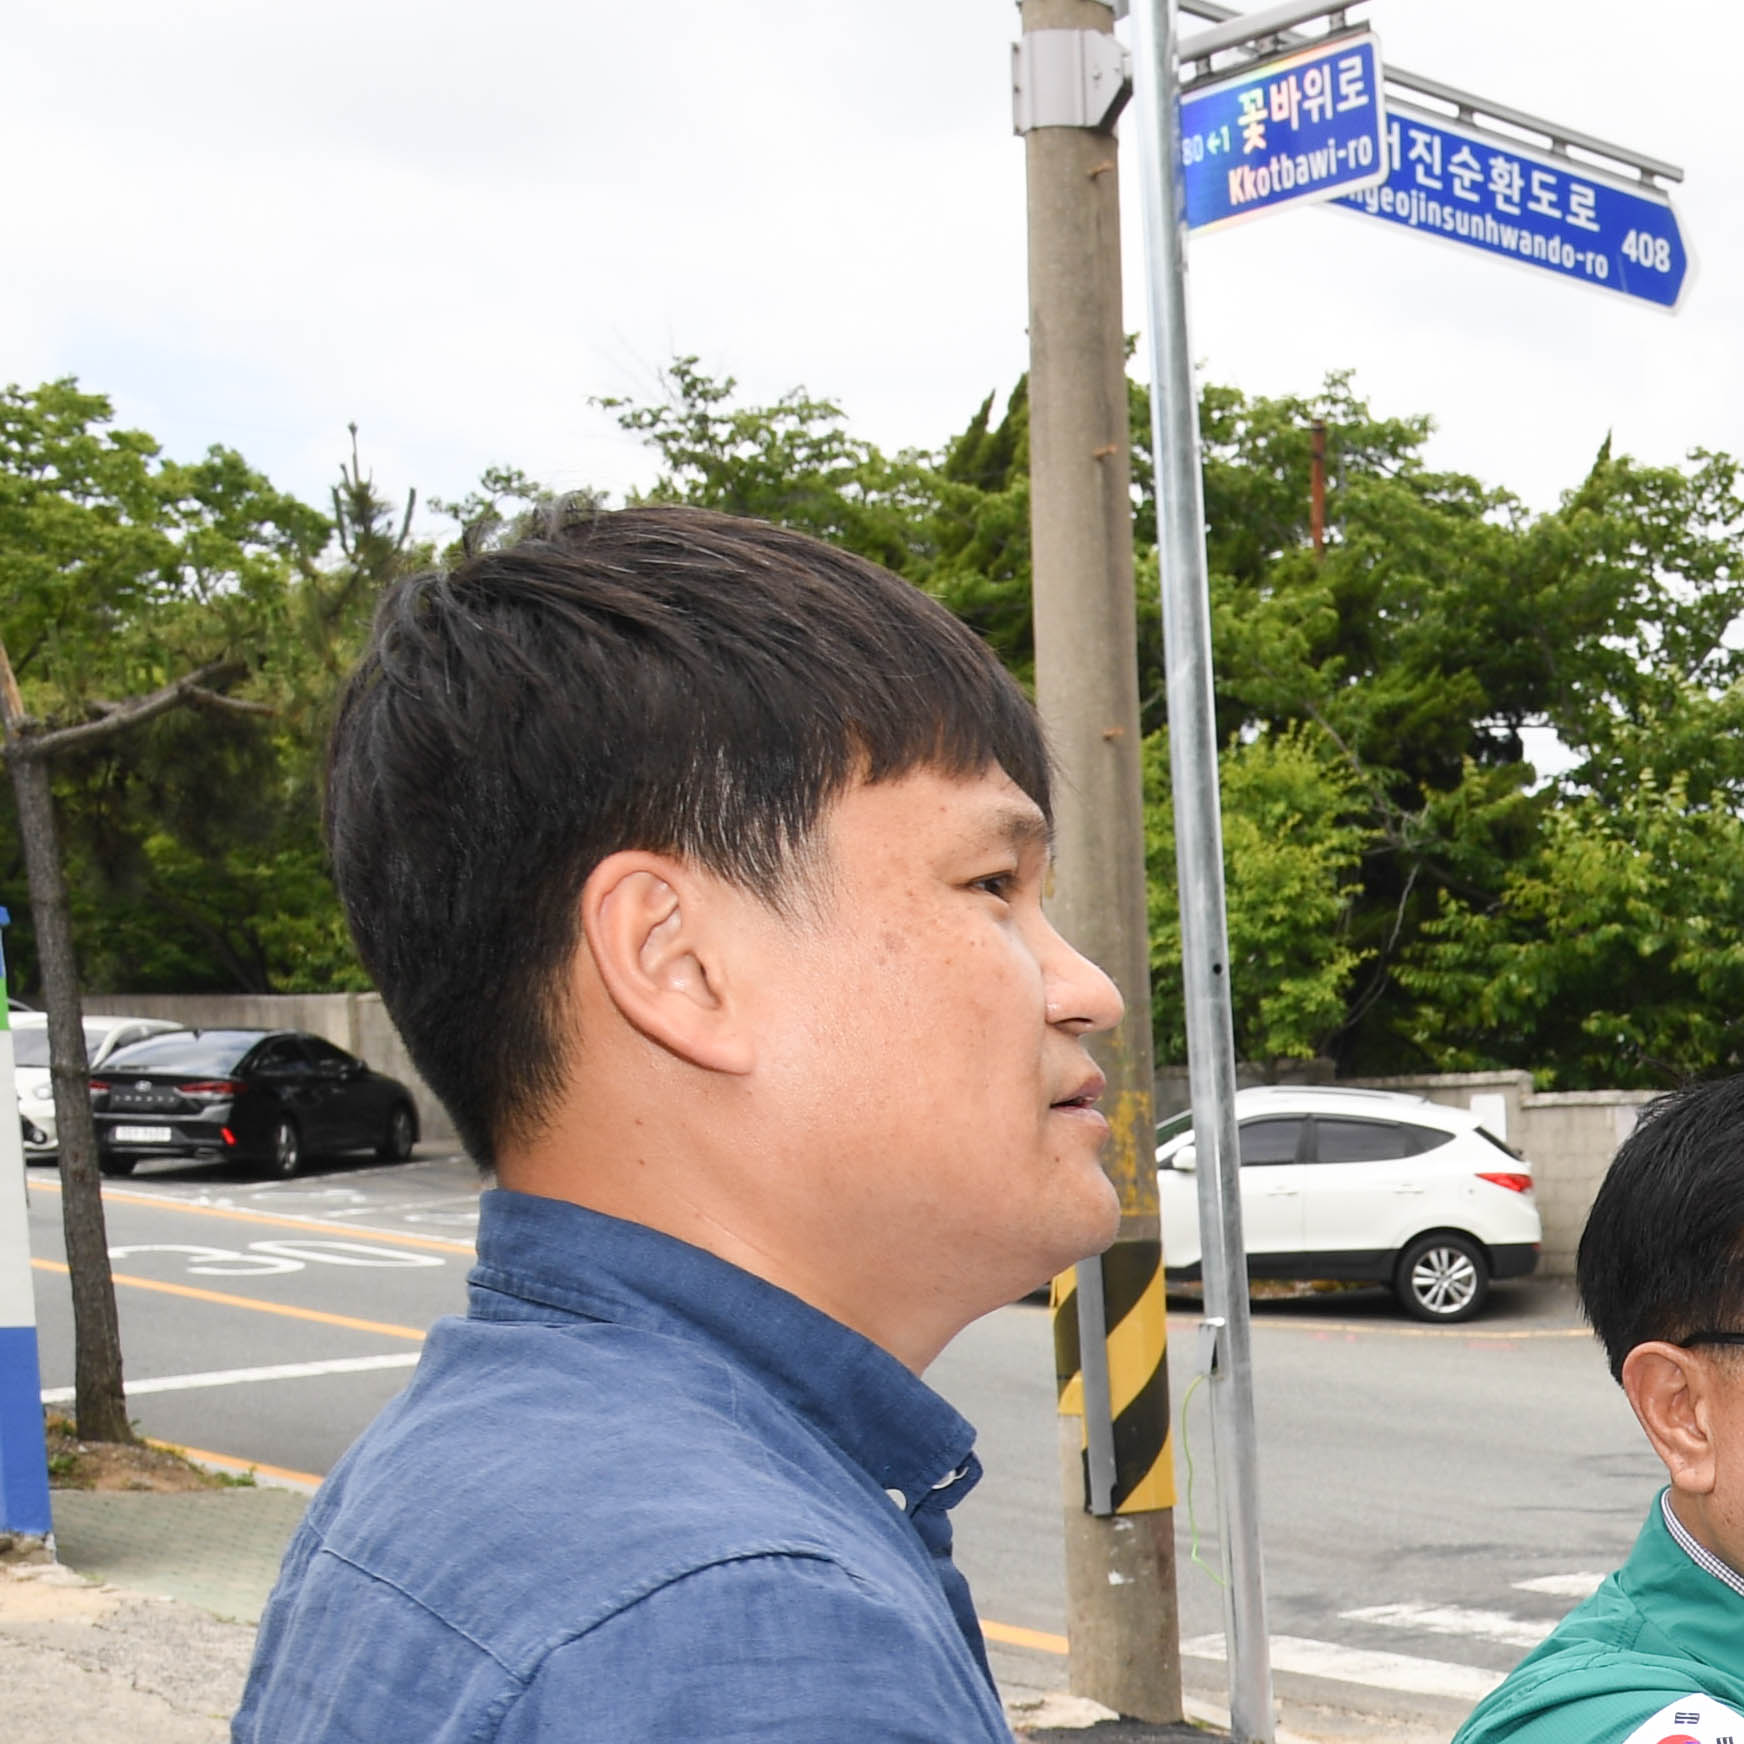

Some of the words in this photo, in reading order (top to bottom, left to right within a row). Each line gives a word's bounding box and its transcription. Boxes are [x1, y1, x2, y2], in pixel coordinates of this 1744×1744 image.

[1236, 55, 1369, 155] 꽃바위로
[1228, 134, 1373, 206] Kkotbawi-ro
[1621, 229, 1672, 273] 408
